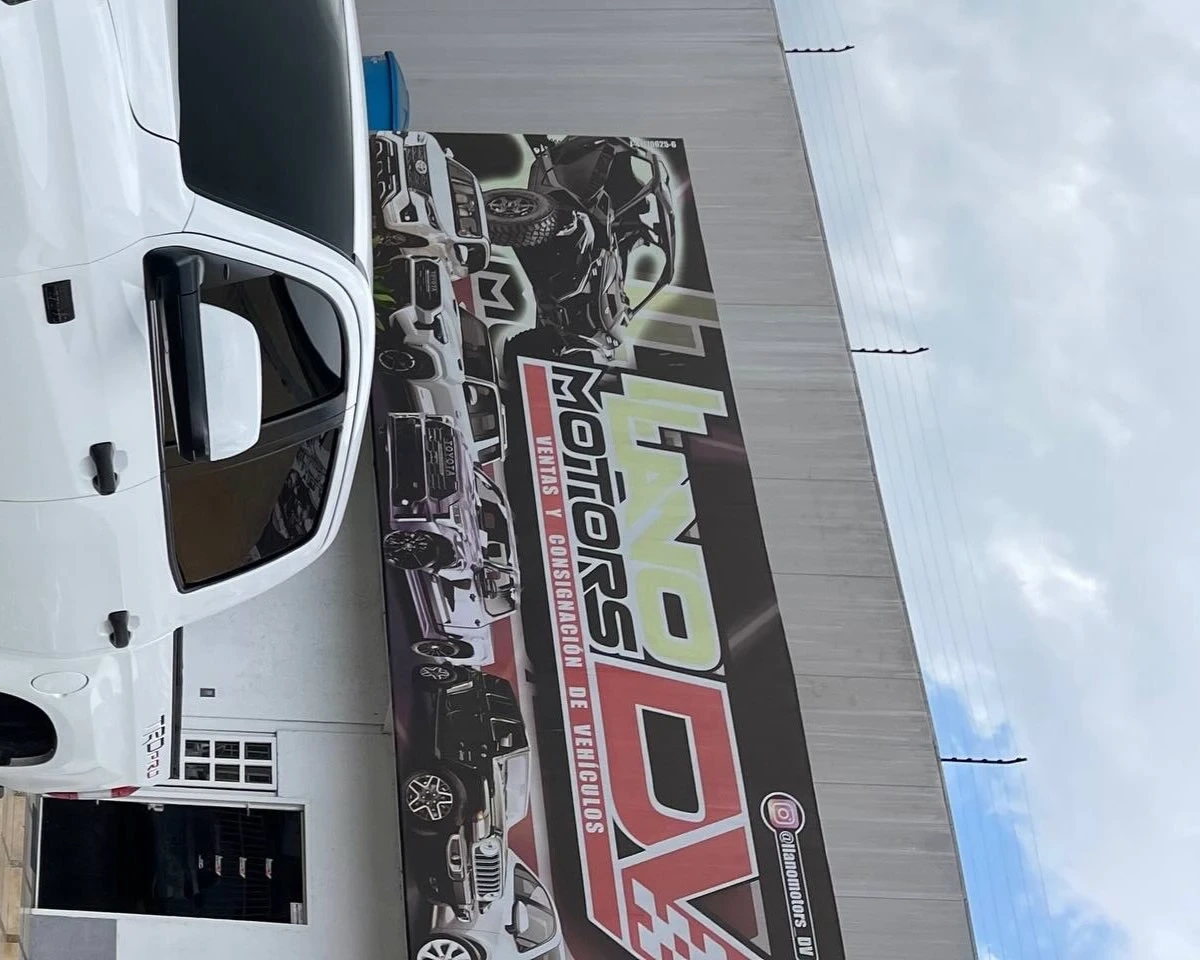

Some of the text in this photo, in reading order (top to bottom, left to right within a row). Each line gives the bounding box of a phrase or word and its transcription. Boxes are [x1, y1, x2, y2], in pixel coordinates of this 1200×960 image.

[444, 440, 455, 477] TOYOTA
[551, 366, 637, 654] MOTORS
[142, 715, 165, 752] TRD
[535, 436, 604, 834] VENTAS Y CONSIGNACIÓN DE VEHÍCULOS
[593, 658, 759, 960] DV
